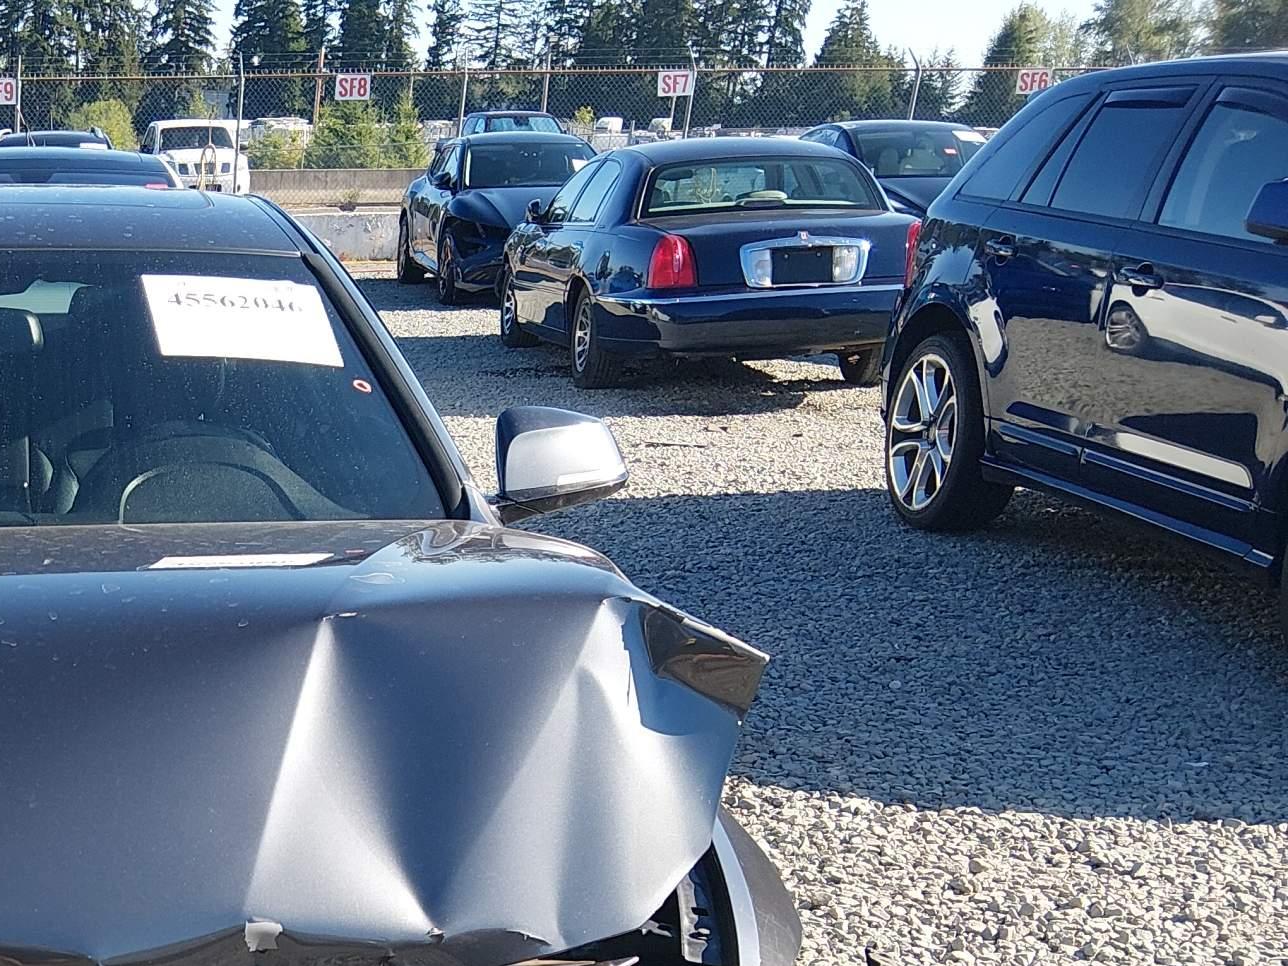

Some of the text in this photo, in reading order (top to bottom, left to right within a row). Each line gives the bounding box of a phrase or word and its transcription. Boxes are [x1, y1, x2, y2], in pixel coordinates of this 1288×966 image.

[338, 77, 368, 97] SF8
[662, 74, 689, 94] SF7
[1019, 71, 1049, 91] SF6
